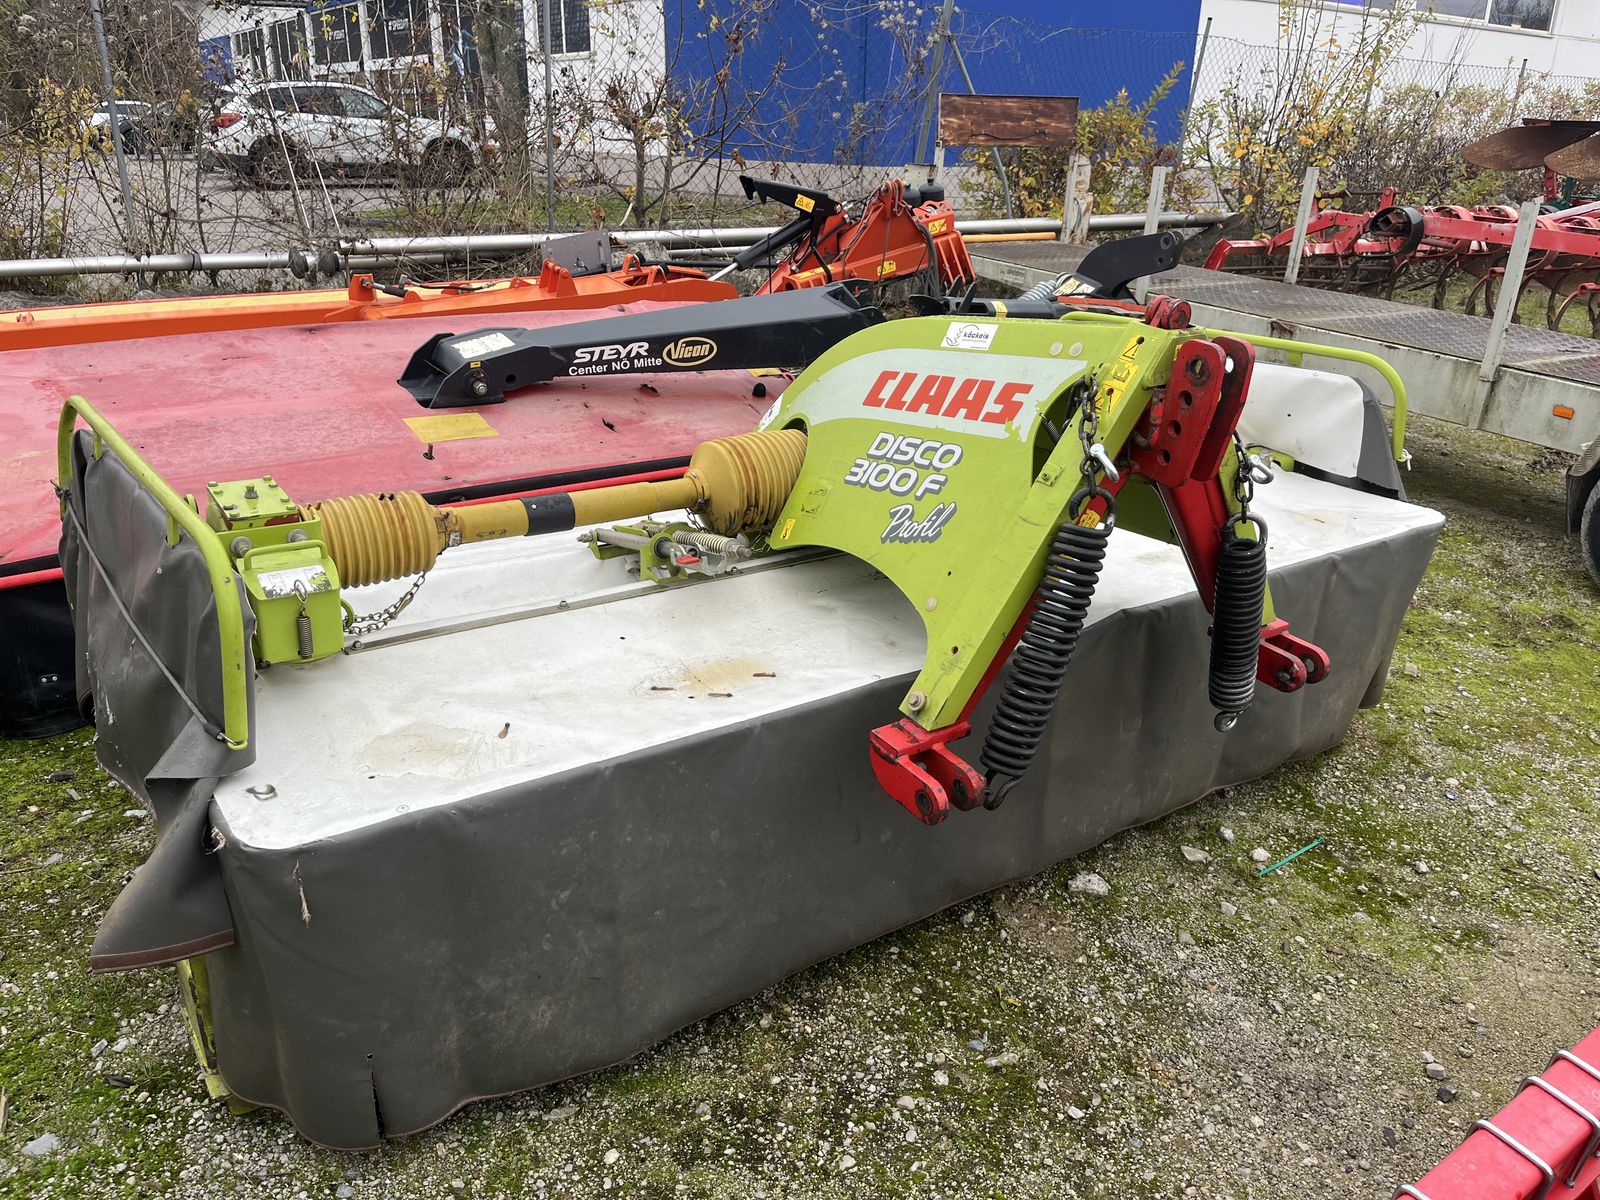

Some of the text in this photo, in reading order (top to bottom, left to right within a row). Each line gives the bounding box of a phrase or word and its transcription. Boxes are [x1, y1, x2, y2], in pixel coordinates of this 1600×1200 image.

[568, 356, 662, 376] Center NÖ Mitte
[573, 341, 649, 363] STEYR
[667, 339, 709, 360] Vicon
[862, 370, 1034, 425] CLAAS
[867, 431, 963, 472] DISCO
[844, 458, 948, 501] 3100 F
[881, 502, 957, 544] Profil
